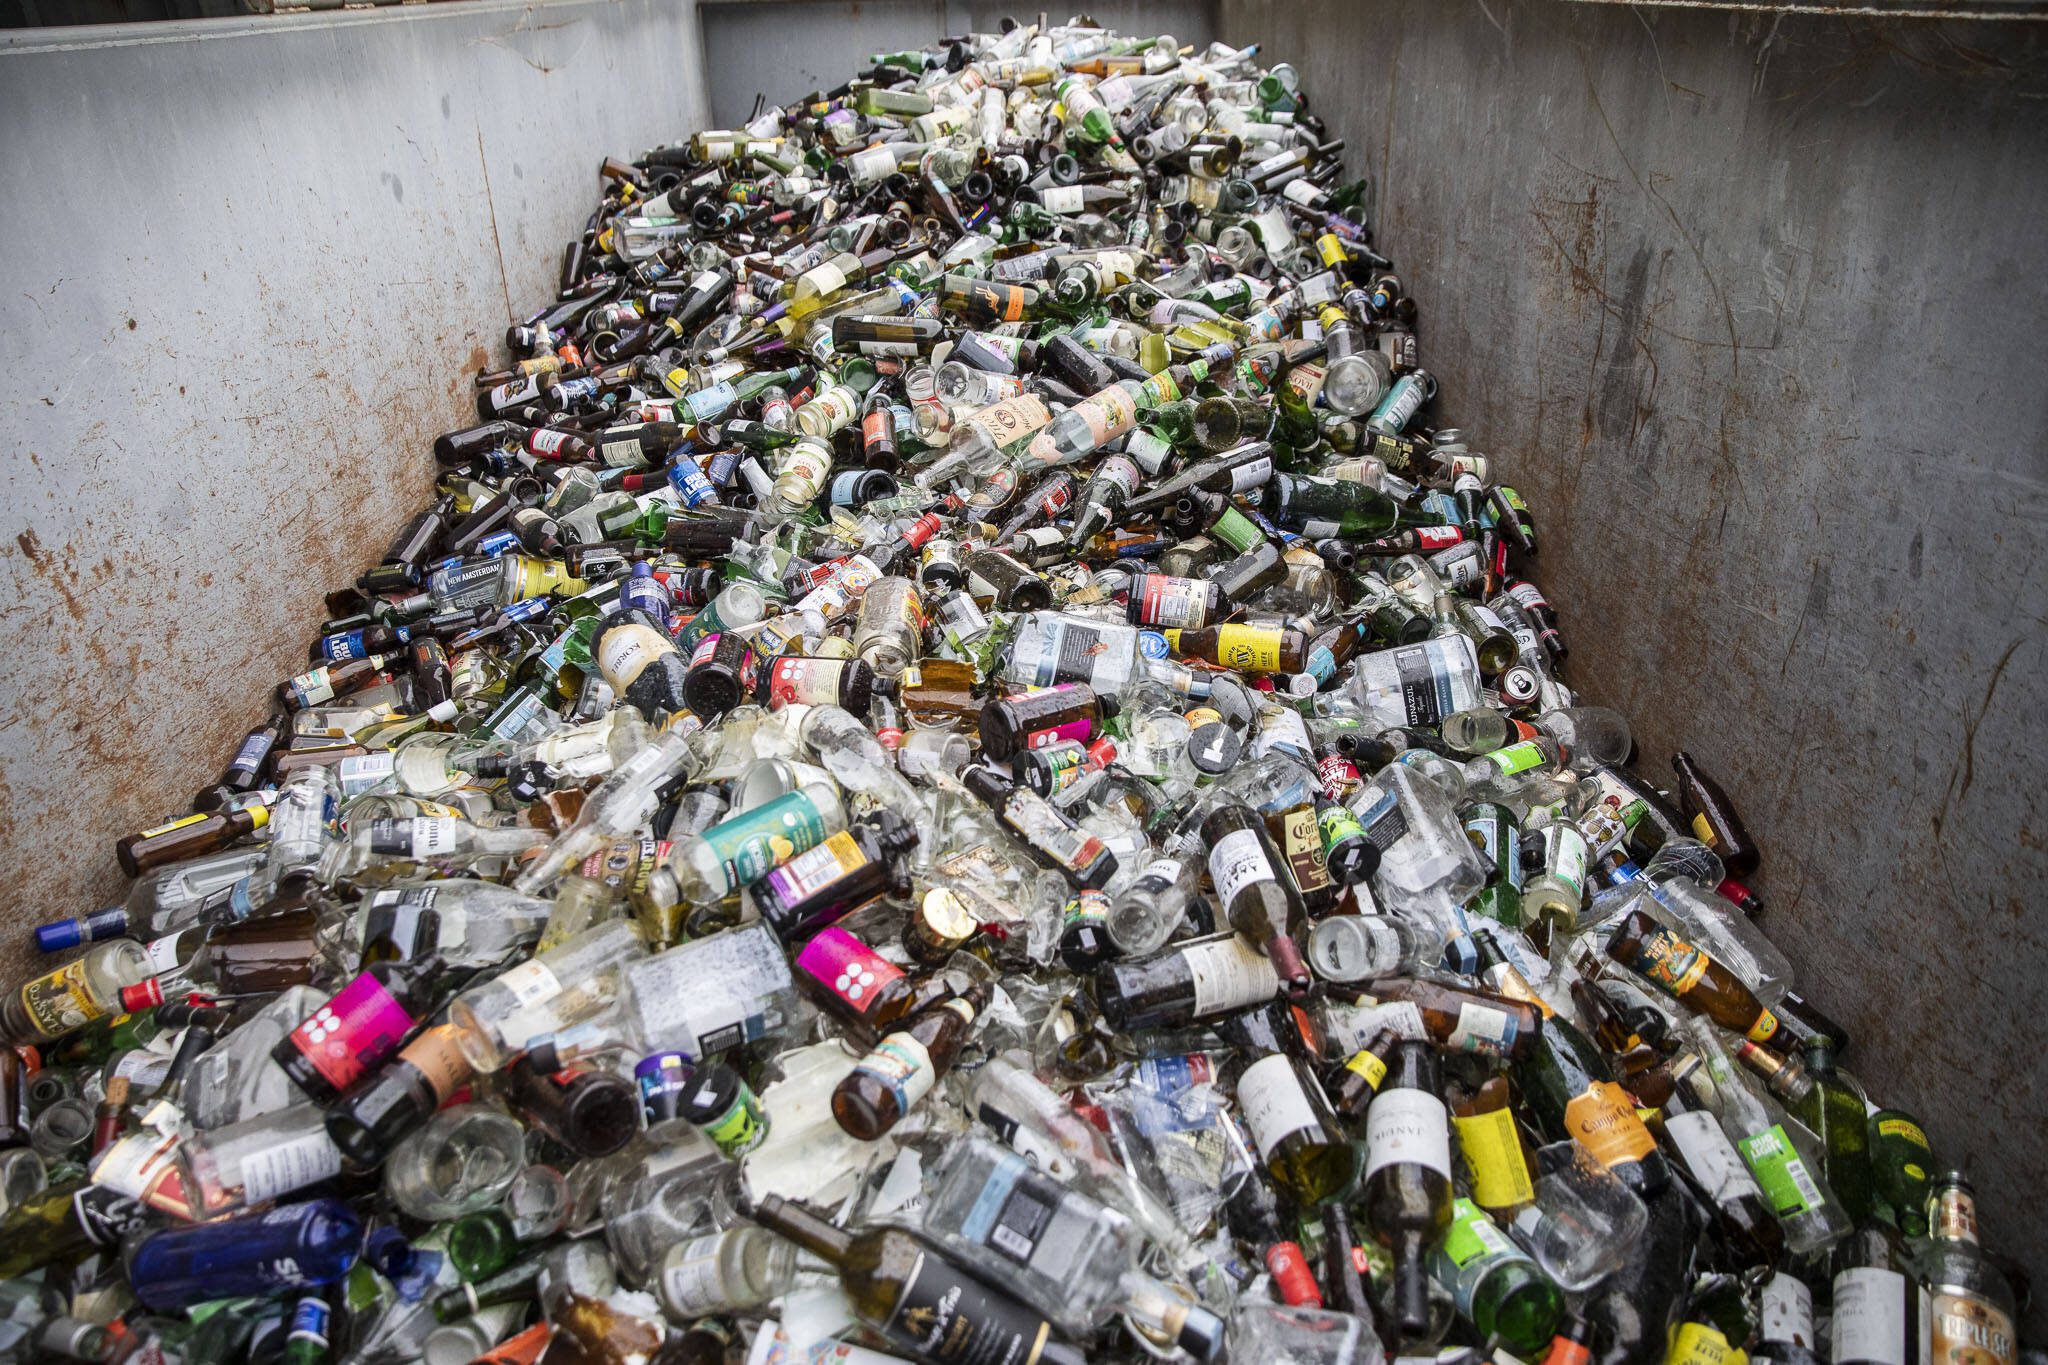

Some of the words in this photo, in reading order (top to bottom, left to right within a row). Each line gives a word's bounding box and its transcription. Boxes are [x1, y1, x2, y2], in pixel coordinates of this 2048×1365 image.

[684, 471, 706, 486] BUD
[447, 575, 461, 586] NEW
[462, 563, 501, 581] AMSTERDAM
[340, 641, 353, 660] BU
[611, 642, 641, 674] KORBEL
[1407, 685, 1418, 725] LUNAZUL
[1651, 938, 1669, 960] YUZU
[29, 983, 65, 1034] CLASSICO
[1750, 1134, 1773, 1150] BUD
[1939, 1313, 1988, 1347] TRIPLE
